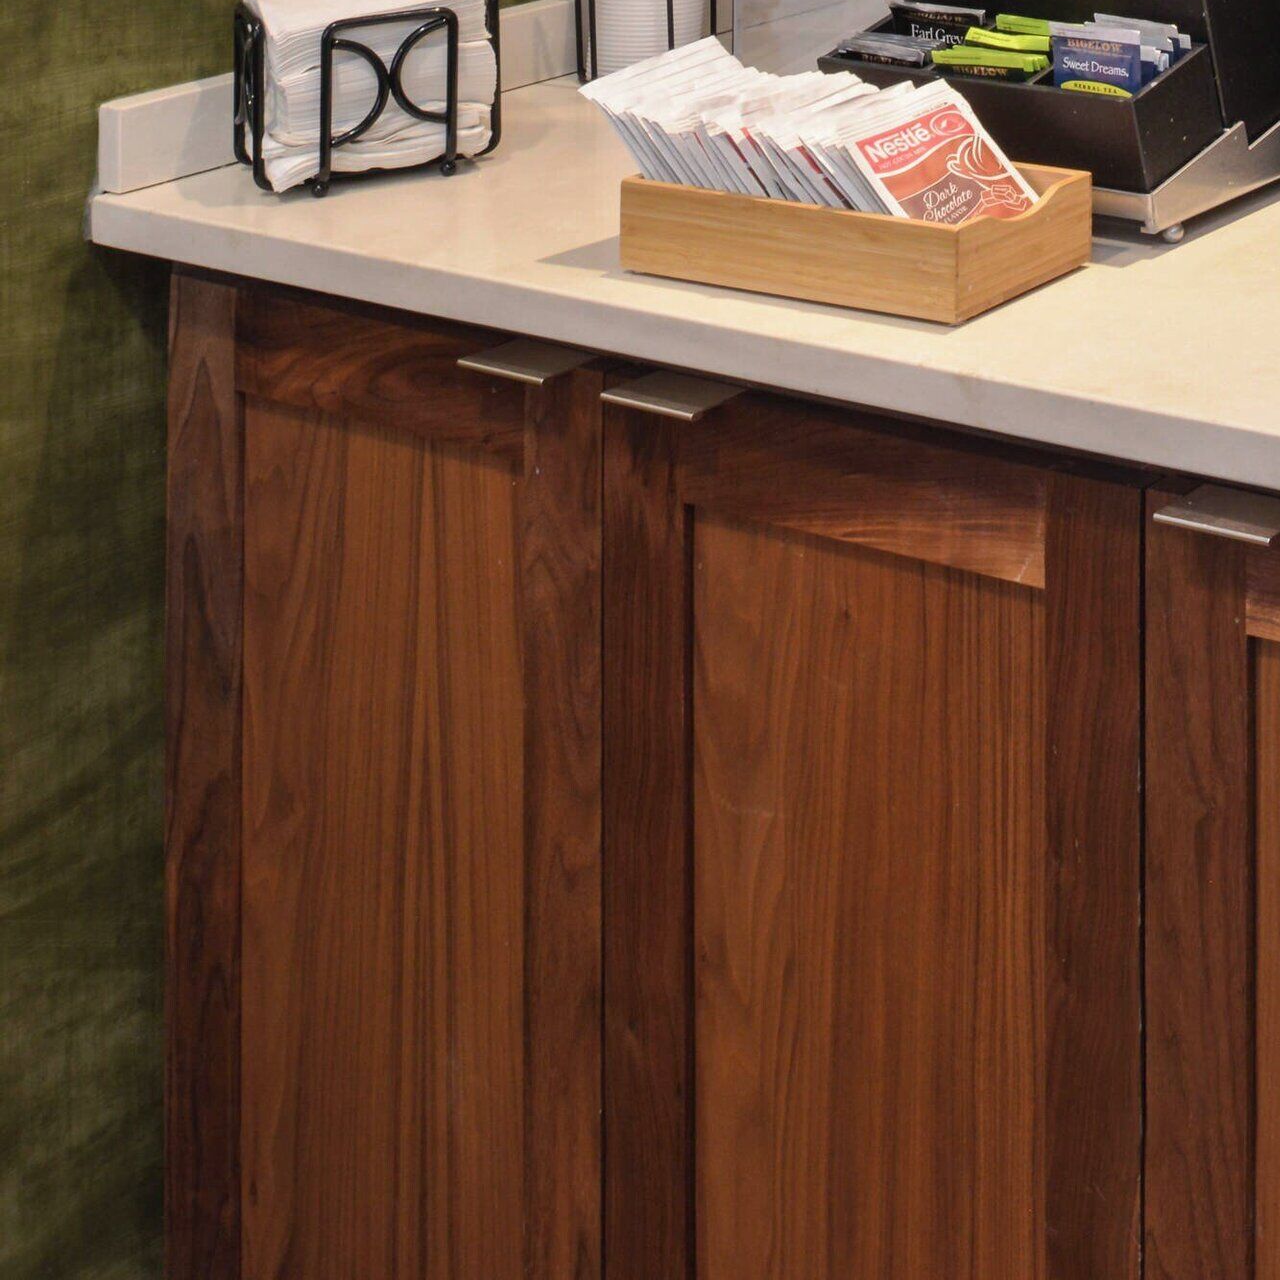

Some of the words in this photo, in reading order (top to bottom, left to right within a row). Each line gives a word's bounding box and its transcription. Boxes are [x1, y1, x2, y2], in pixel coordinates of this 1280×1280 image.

[911, 23, 933, 40] Earl
[1067, 38, 1122, 53] BIGELOW
[1062, 56, 1090, 72] Sweet
[923, 182, 959, 209] Dark
[923, 189, 973, 224] Chocolate
